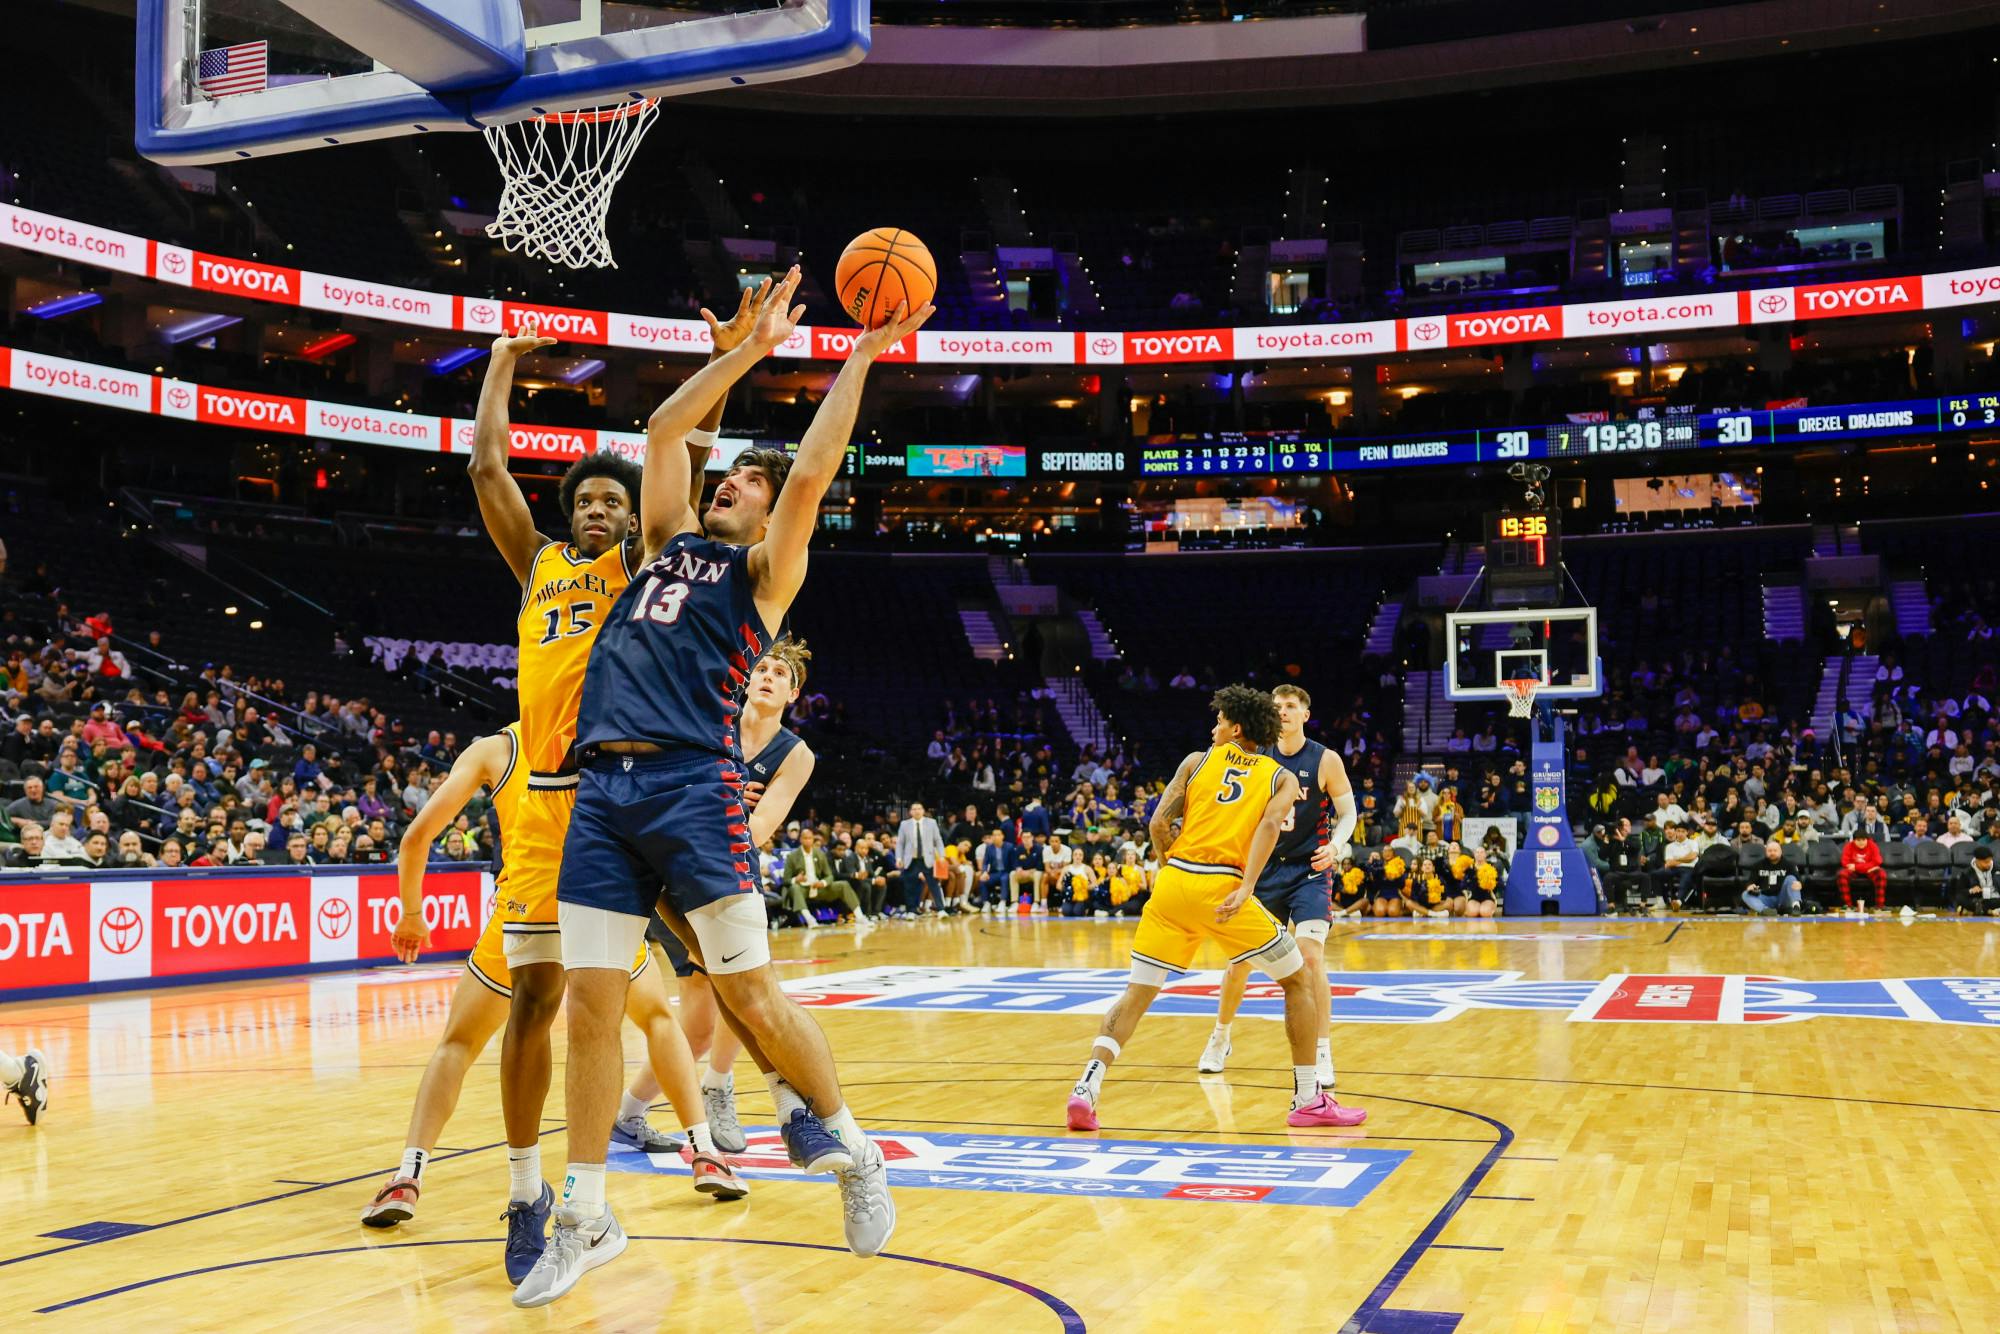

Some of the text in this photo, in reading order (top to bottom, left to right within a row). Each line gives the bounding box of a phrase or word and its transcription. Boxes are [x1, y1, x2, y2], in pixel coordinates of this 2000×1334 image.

[11, 214, 126, 259] toyota.com
[199, 259, 290, 295] TOYOTA
[323, 281, 431, 315] toyota.com
[1803, 285, 1910, 311] TOYOTA
[508, 308, 598, 335] TOYOTA
[1587, 300, 1714, 327] toyota.com
[629, 321, 712, 343] toyota.c
[1455, 314, 1551, 338] TOYOTA
[818, 333, 906, 355] TOYA
[940, 336, 1053, 356] toyota.com
[1131, 334, 1223, 356] TOYOTA
[1256, 329, 1374, 351] toyota.com
[25, 360, 139, 398] toyota.com
[203, 393, 295, 425] TOYOTA
[1950, 396, 1999, 411] FLS TOL
[320, 410, 428, 440] toyota.com
[1798, 410, 1914, 433] DREXEL DRAGONS
[1953, 408, 1996, 427] 0 3
[1558, 421, 1693, 453] 7 19:36 2ND
[1717, 415, 1753, 444] 30
[1143, 446, 1265, 460] PLAYER 2 11 13 23 33
[1279, 442, 1322, 454] FLS TOL
[1359, 441, 1449, 461] PENN QUAKERS
[1496, 431, 1530, 458] 30
[847, 453, 855, 463] 3
[847, 464, 855, 474] 3
[865, 455, 888, 466] 3:09
[1041, 452, 1125, 471] SEPTEMBER 6
[1144, 462, 1179, 472] POINTS
[1186, 461, 1193, 471] 3
[1237, 459, 1244, 469] 7
[1254, 459, 1263, 469] 0
[1282, 453, 1319, 468] 0 3
[1501, 516, 1547, 537] 19:36
[1523, 534, 1545, 566] 7
[632, 576, 690, 626] 13
[539, 600, 596, 647] 15
[1216, 767, 1249, 805] 5
[165, 900, 298, 948] TOYOTA
[367, 893, 472, 935] TOOTA
[961, 1139, 1350, 1161] CLASSIC
[942, 1152, 1300, 1178] BIG
[928, 1173, 1147, 1194] TOYOTA
